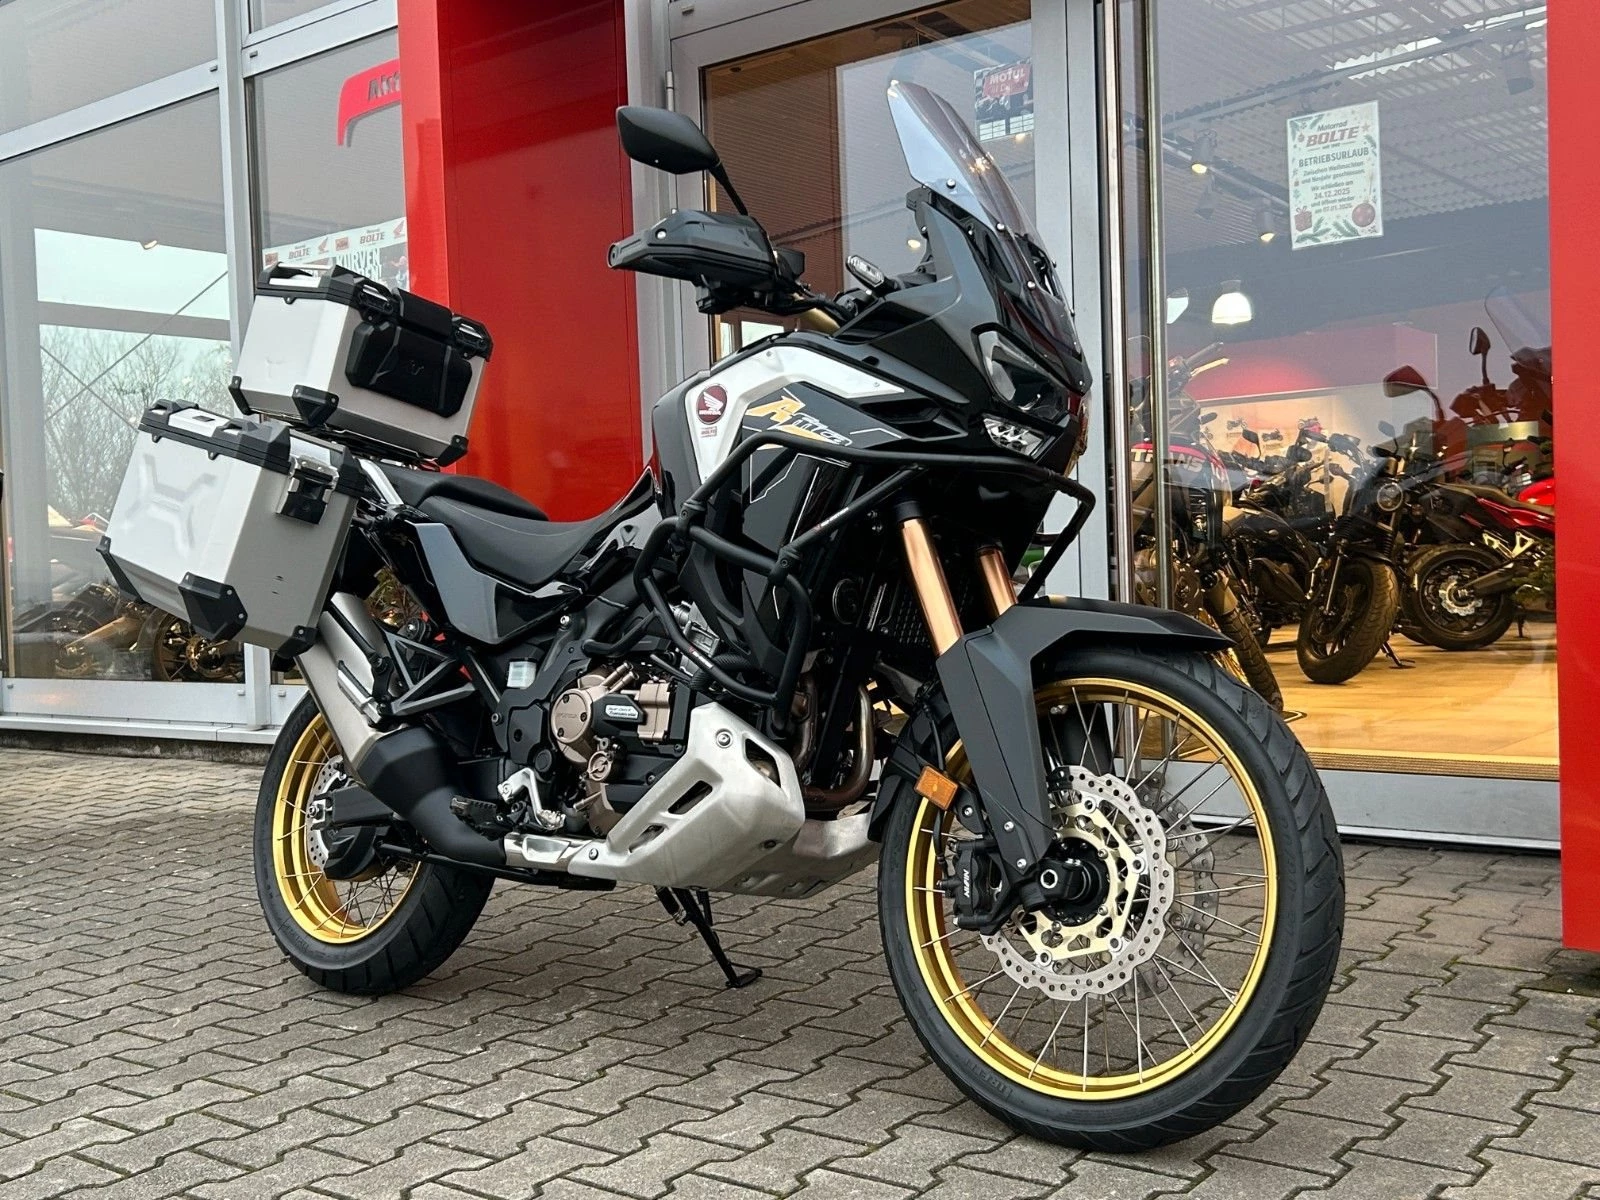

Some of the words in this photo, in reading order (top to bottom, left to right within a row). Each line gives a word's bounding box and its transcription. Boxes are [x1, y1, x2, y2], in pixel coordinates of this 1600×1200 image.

[990, 68, 1025, 84] MOTUL
[1317, 121, 1348, 131] Motorrad
[1306, 127, 1359, 147] BOLTE
[1299, 147, 1369, 167] BETRIEBSURLAUB
[1314, 188, 1350, 200] 24.12.2025
[360, 232, 385, 245] BOLTE
[336, 248, 381, 272] KURVEN
